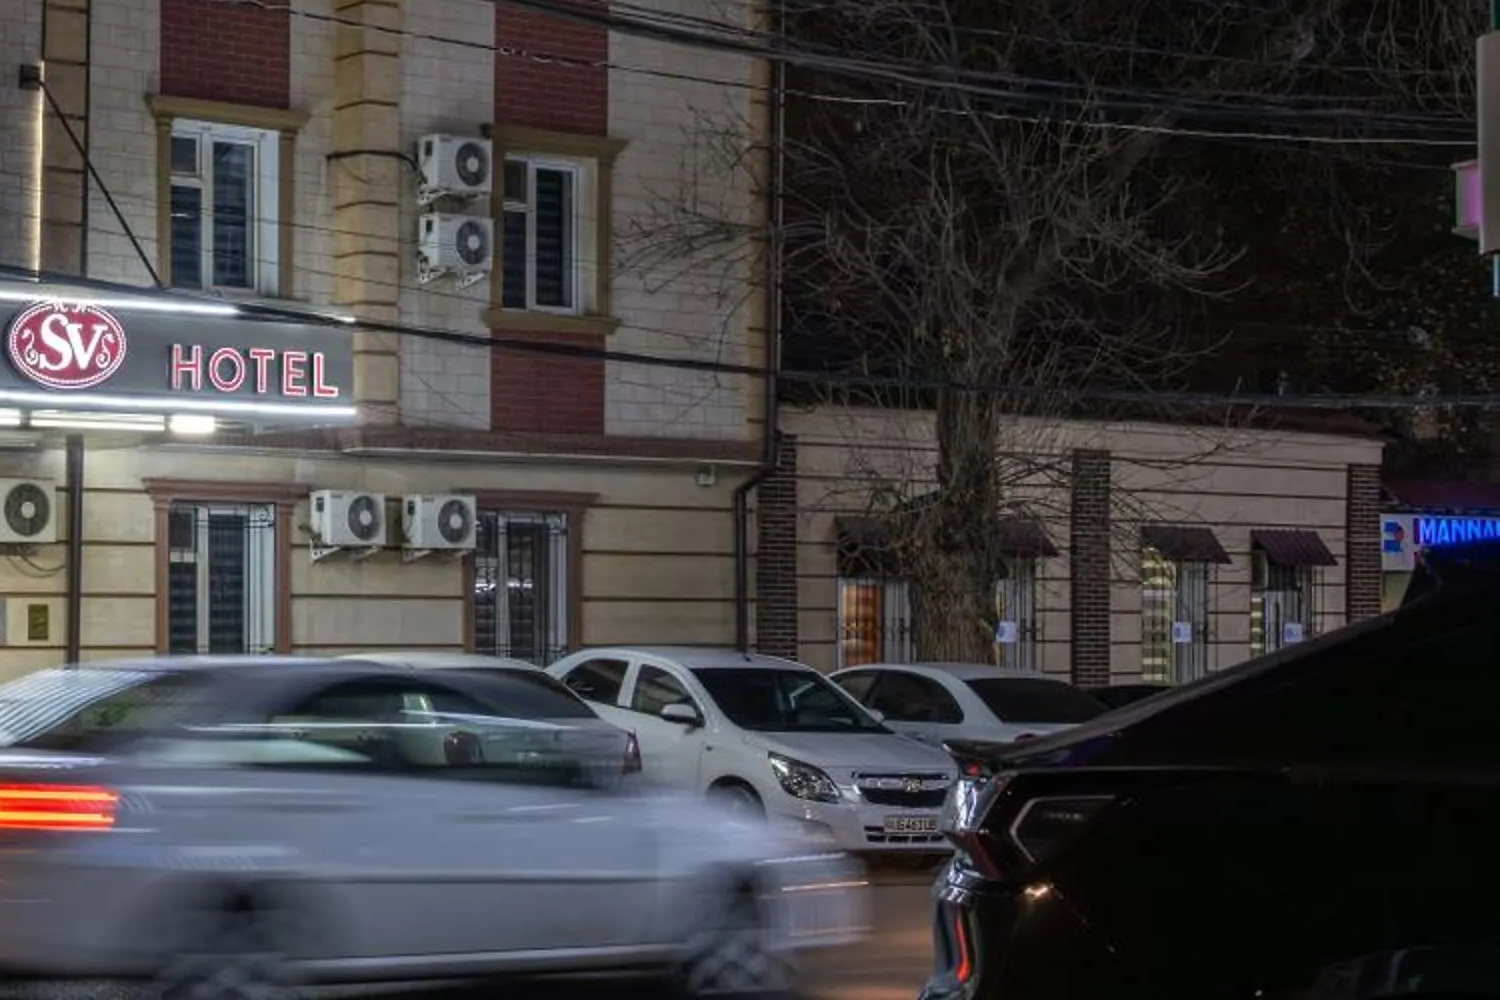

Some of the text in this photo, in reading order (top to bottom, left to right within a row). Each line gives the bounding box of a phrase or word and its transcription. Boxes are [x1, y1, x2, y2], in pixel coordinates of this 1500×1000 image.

[39, 313, 108, 371] SV
[171, 343, 340, 398] HOTEL
[1419, 518, 1500, 545] MANNA
